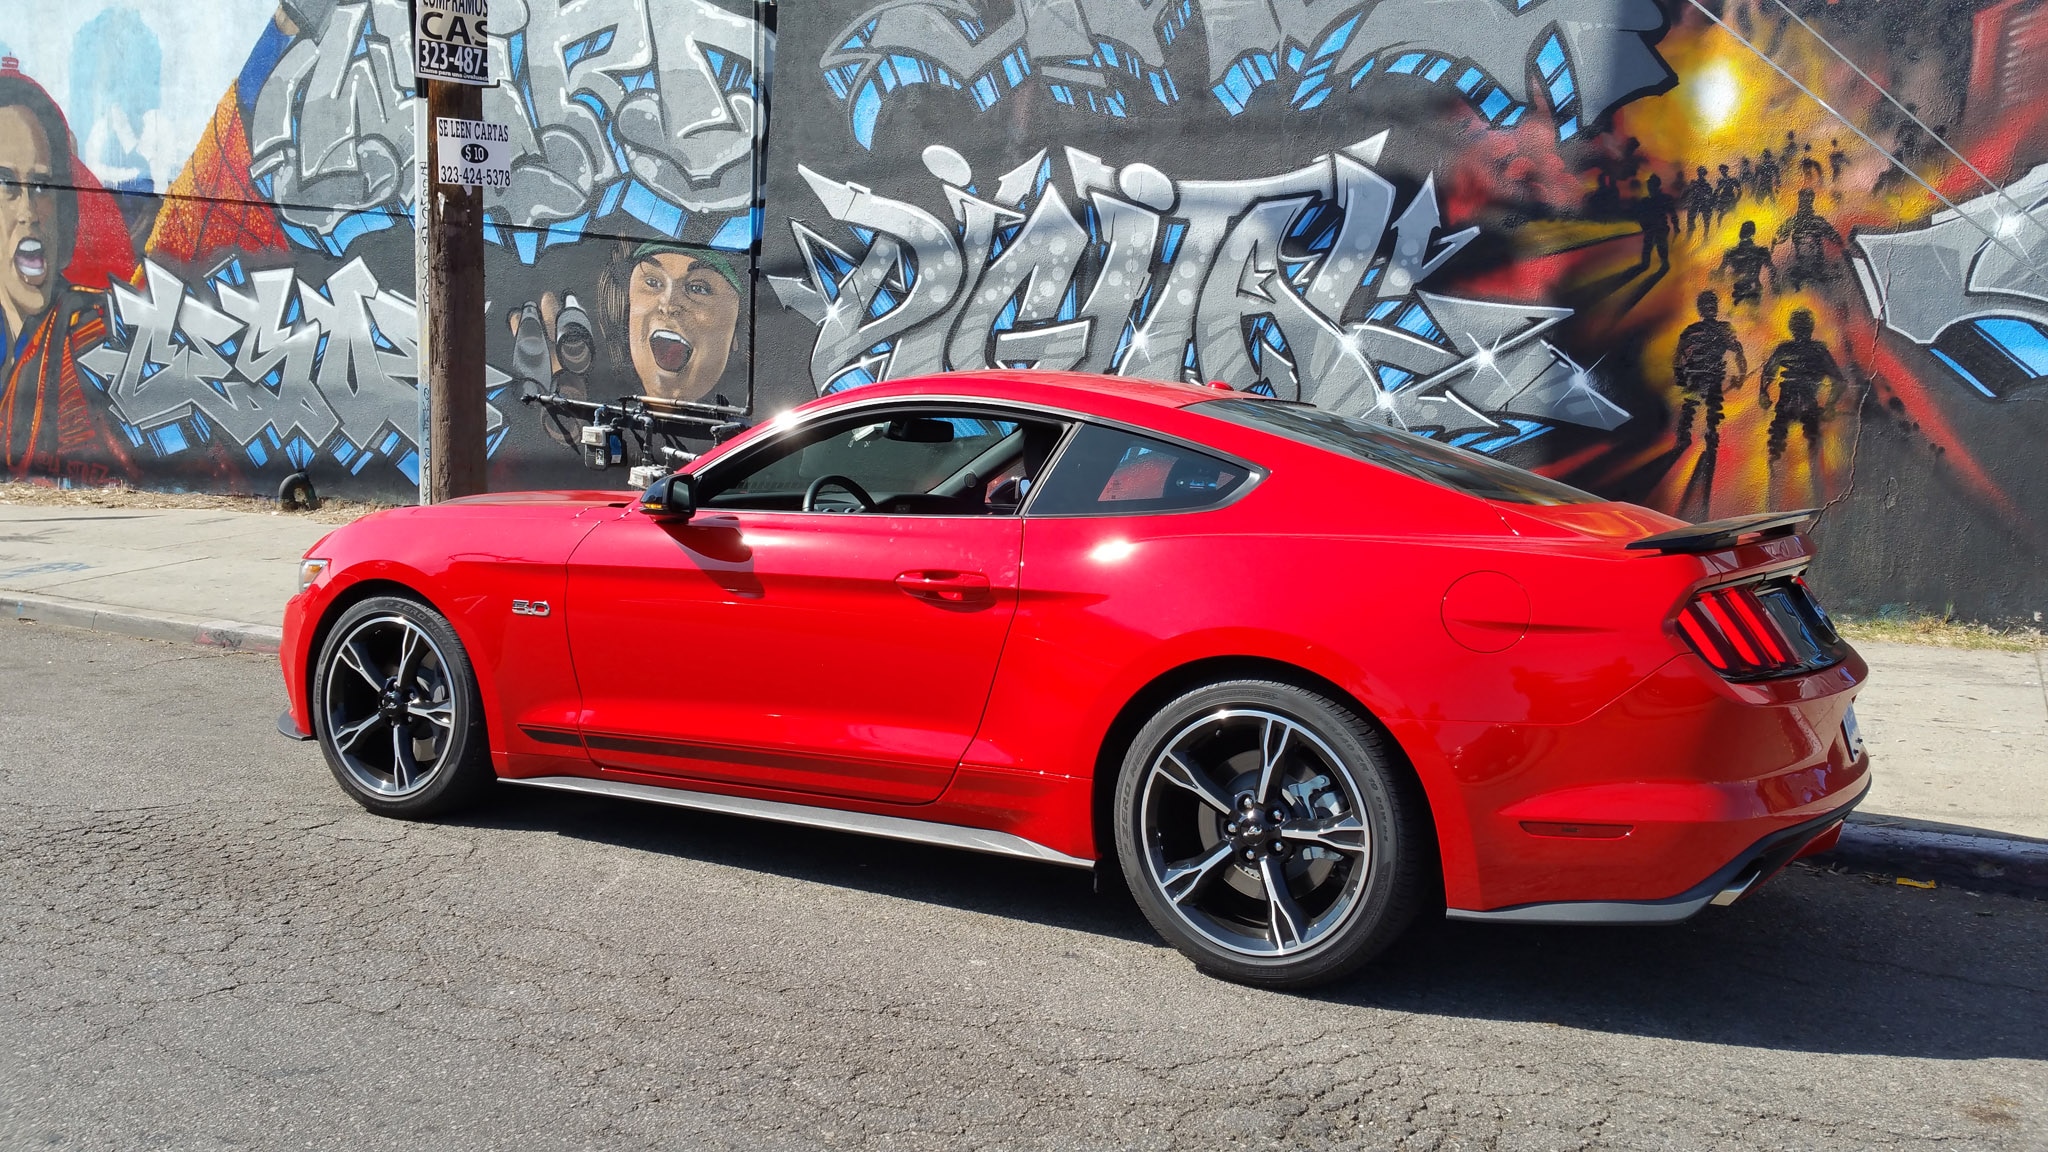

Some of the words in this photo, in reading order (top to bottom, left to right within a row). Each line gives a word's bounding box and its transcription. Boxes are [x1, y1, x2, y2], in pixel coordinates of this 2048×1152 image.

[439, 119, 449, 137] SE
[450, 120, 472, 139] LEEN
[474, 122, 509, 142] CARTAS
[474, 147, 485, 161] 10
[441, 165, 511, 187] 323-424-5378
[512, 599, 550, 617] 5.0
